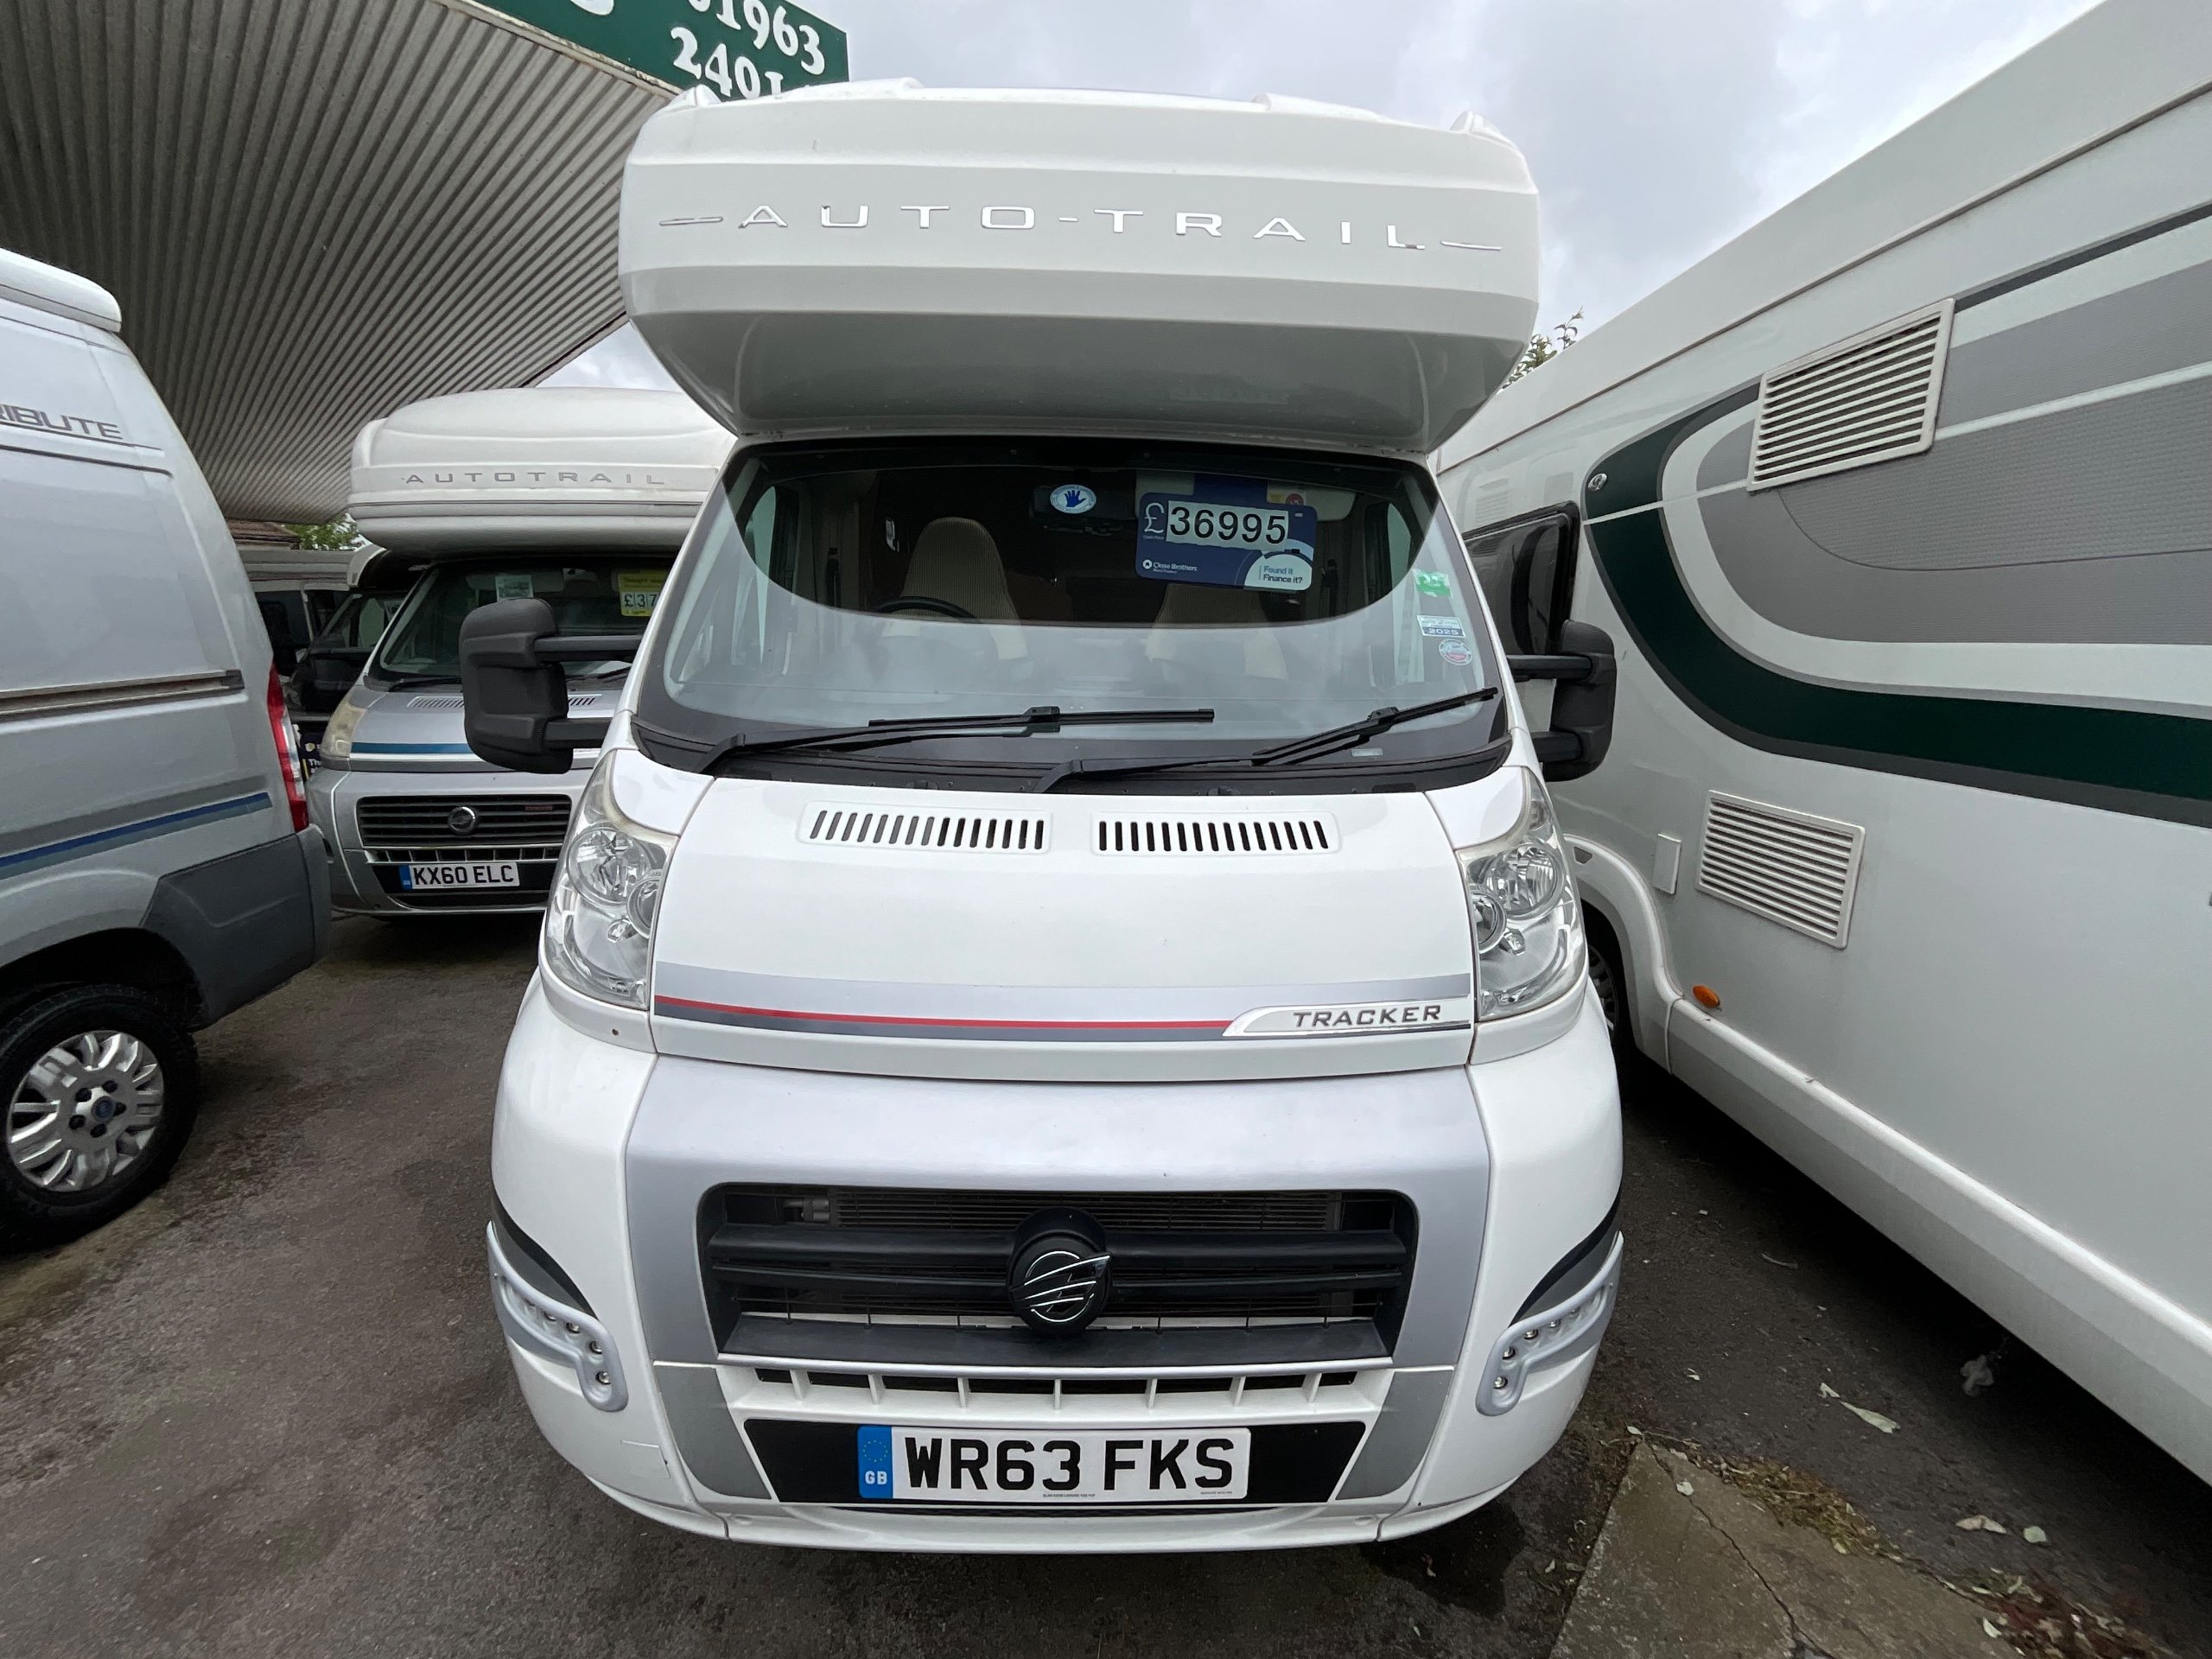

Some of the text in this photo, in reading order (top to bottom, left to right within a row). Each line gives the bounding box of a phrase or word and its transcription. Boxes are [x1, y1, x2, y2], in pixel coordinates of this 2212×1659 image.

[689, 0, 825, 75] 1963
[405, 472, 664, 485] AUTOTRAIL
[1262, 574, 1292, 582] Finance
[1263, 565, 1287, 575] Found
[413, 865, 514, 885] KX60 ELC
[1294, 1005, 1441, 1027] TRACKER
[905, 1437, 1235, 1491] WR63 FKS
[865, 1471, 887, 1485] GB
